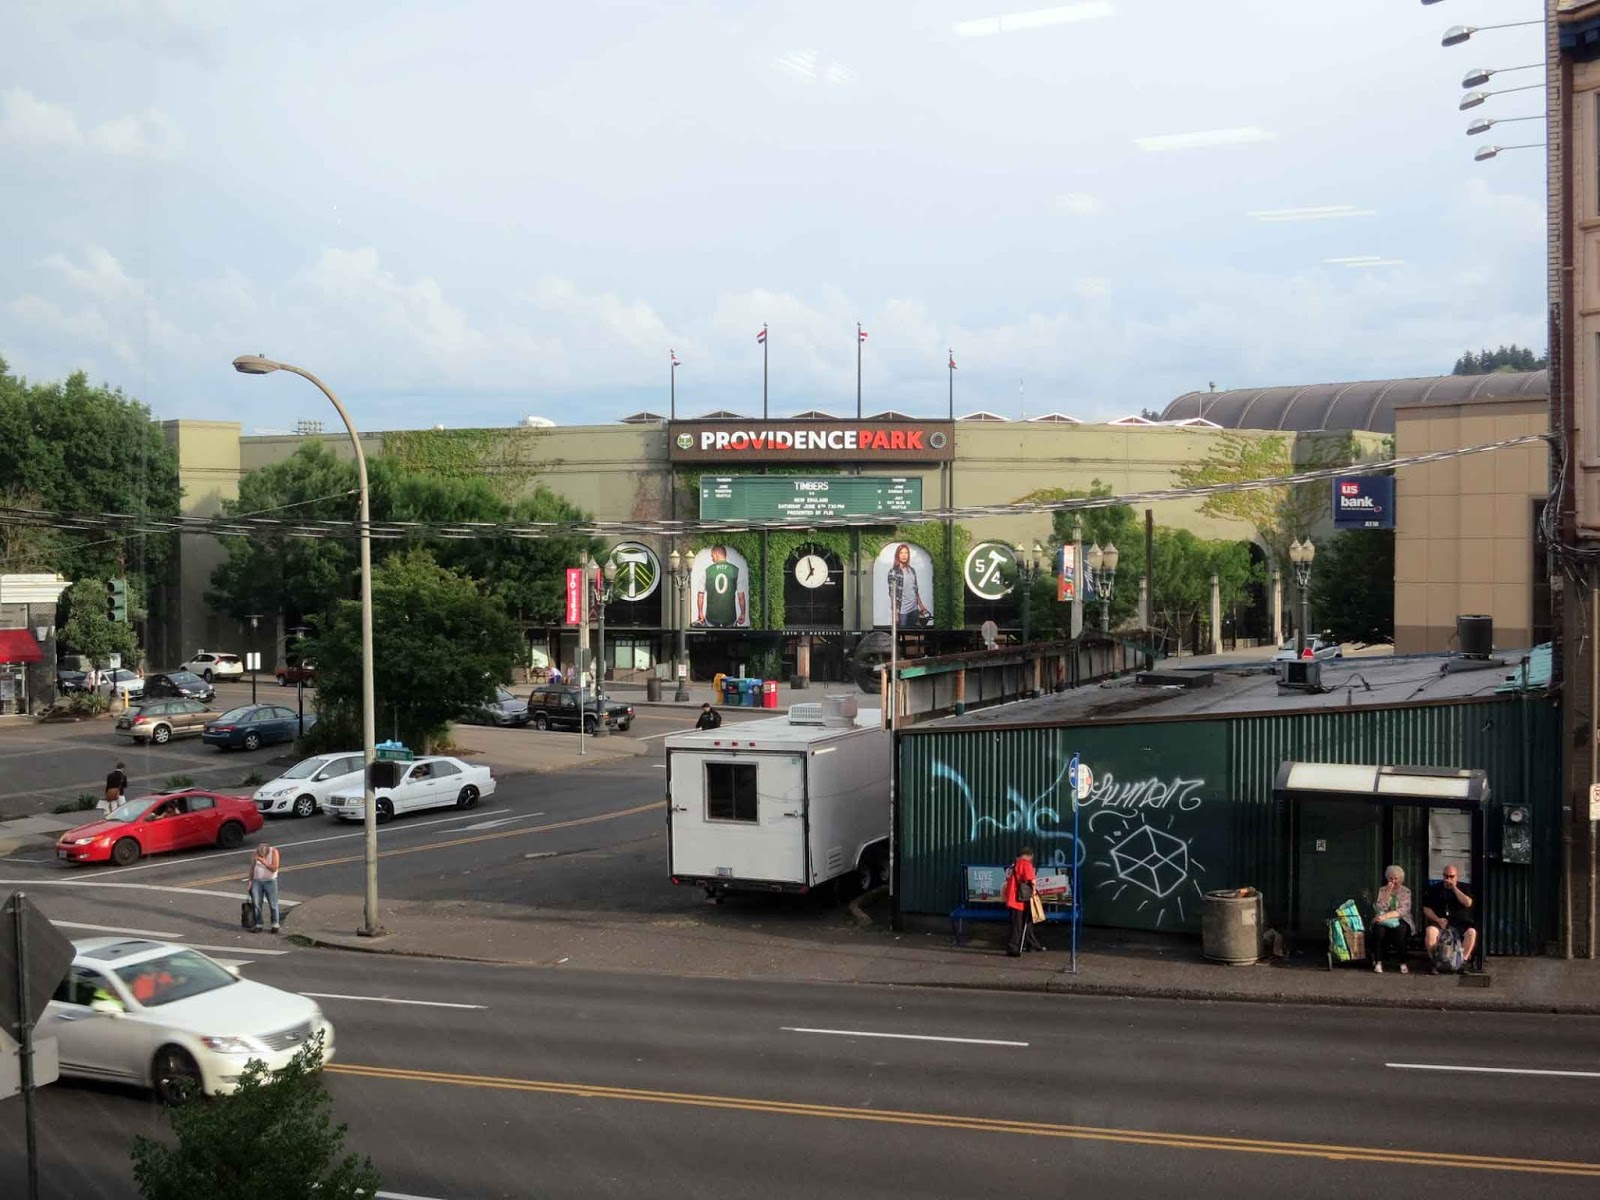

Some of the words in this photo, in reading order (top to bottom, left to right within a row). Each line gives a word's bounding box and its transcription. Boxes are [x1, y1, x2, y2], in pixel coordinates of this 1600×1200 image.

[701, 431, 857, 450] PROVIDENCE
[859, 430, 925, 450] PARK
[794, 481, 829, 490] TIMBERS
[1341, 485, 1359, 494] us
[1340, 496, 1374, 507] bank
[975, 559, 985, 573] 5
[715, 573, 728, 594] 0
